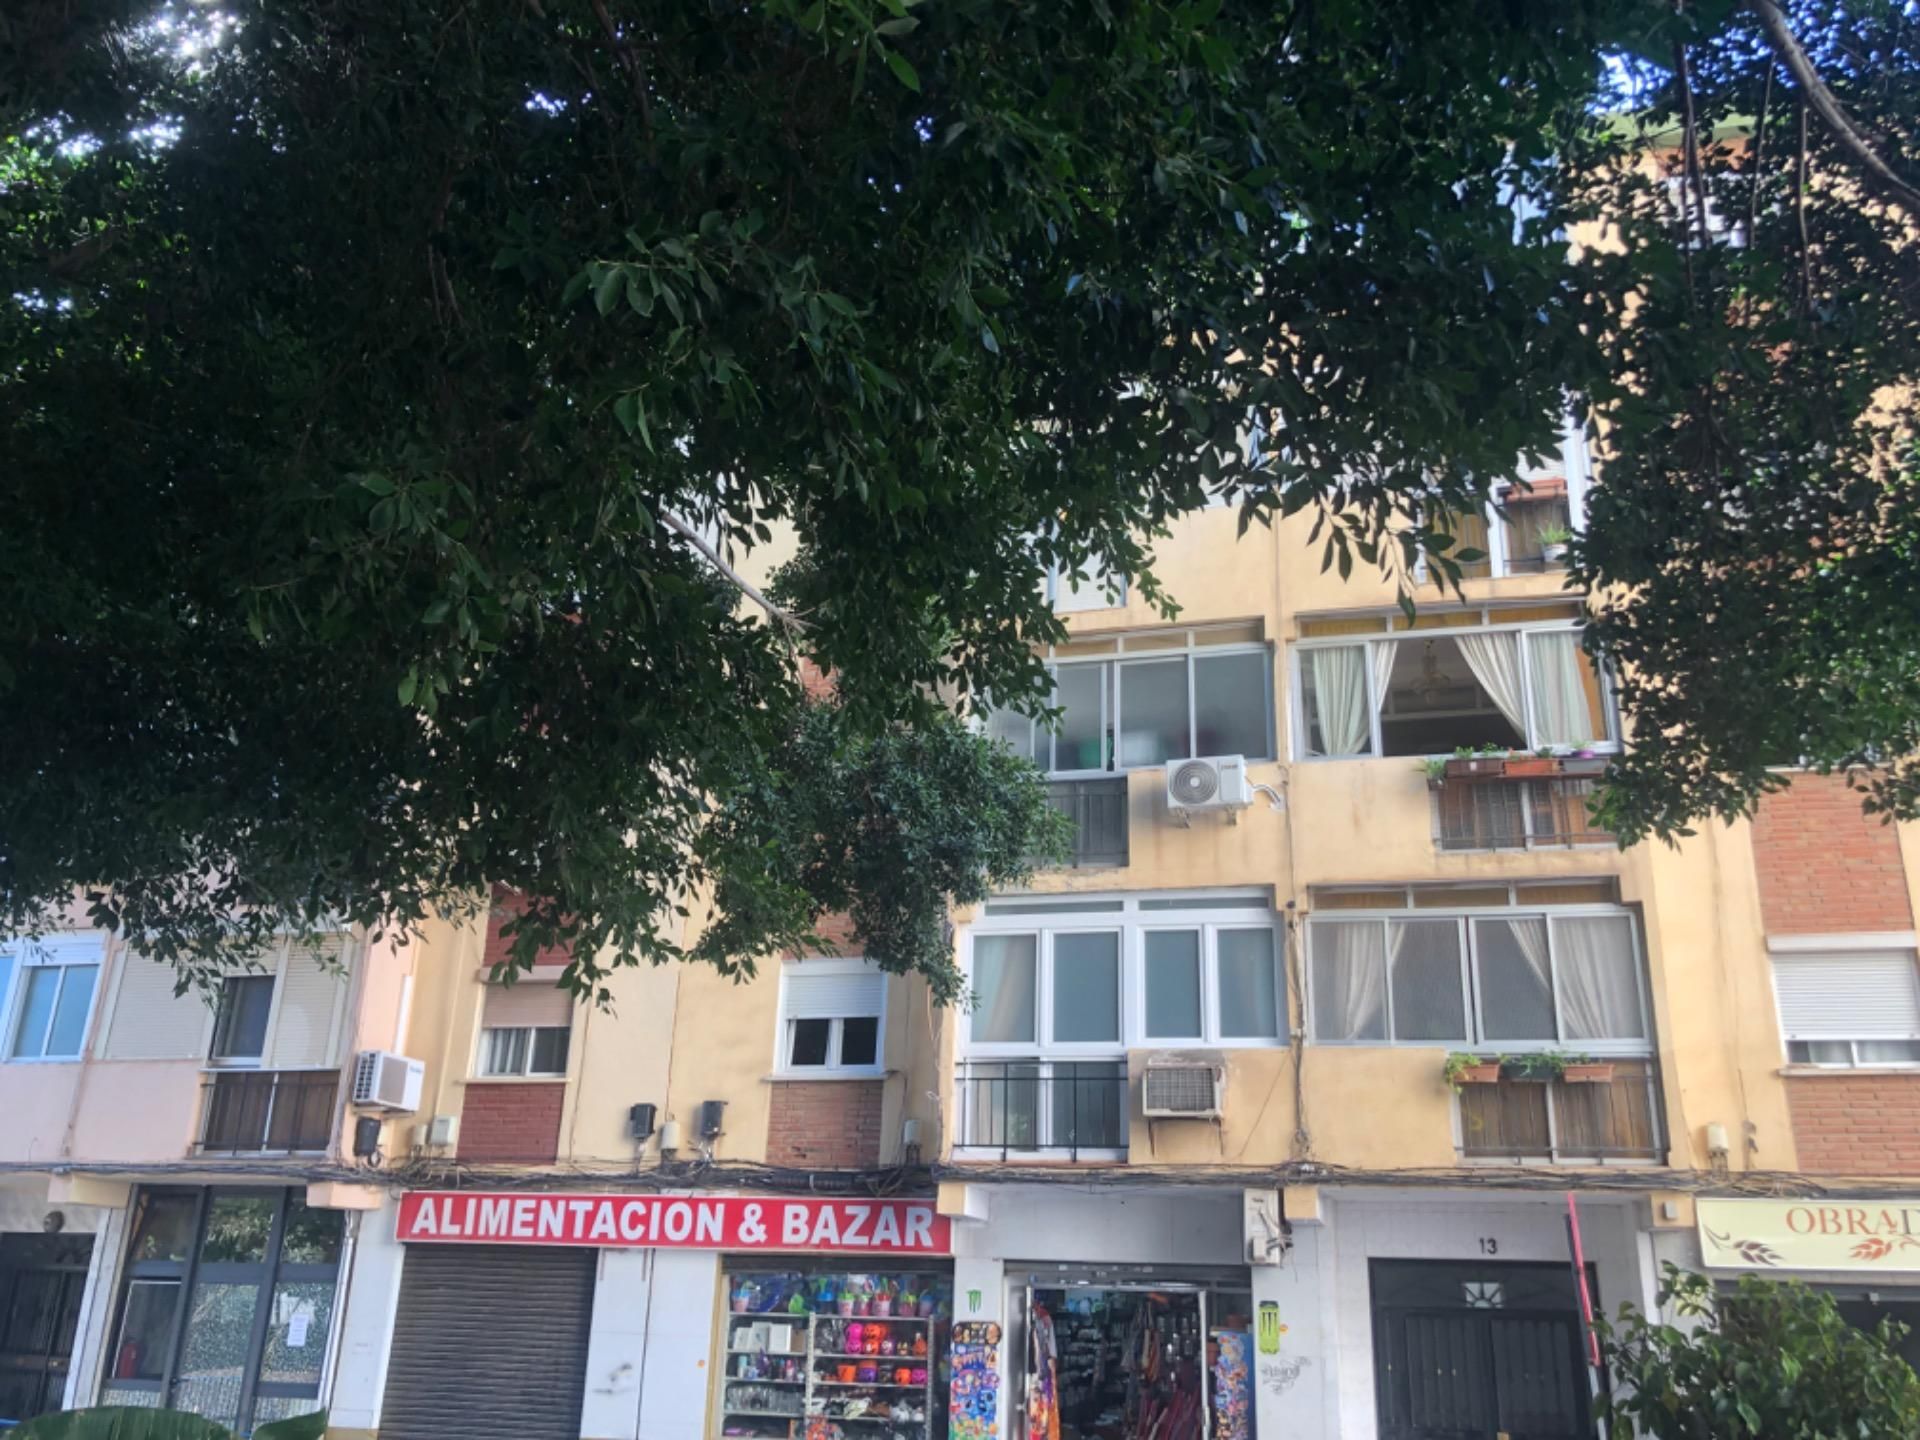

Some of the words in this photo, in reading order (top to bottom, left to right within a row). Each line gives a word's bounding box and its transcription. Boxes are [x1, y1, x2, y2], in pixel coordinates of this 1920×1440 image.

[411, 1197, 724, 1242] ALIMENTACION
[737, 1203, 768, 1244] &
[782, 1204, 933, 1248] BAZAR
[1479, 1237, 1498, 1255] 13
